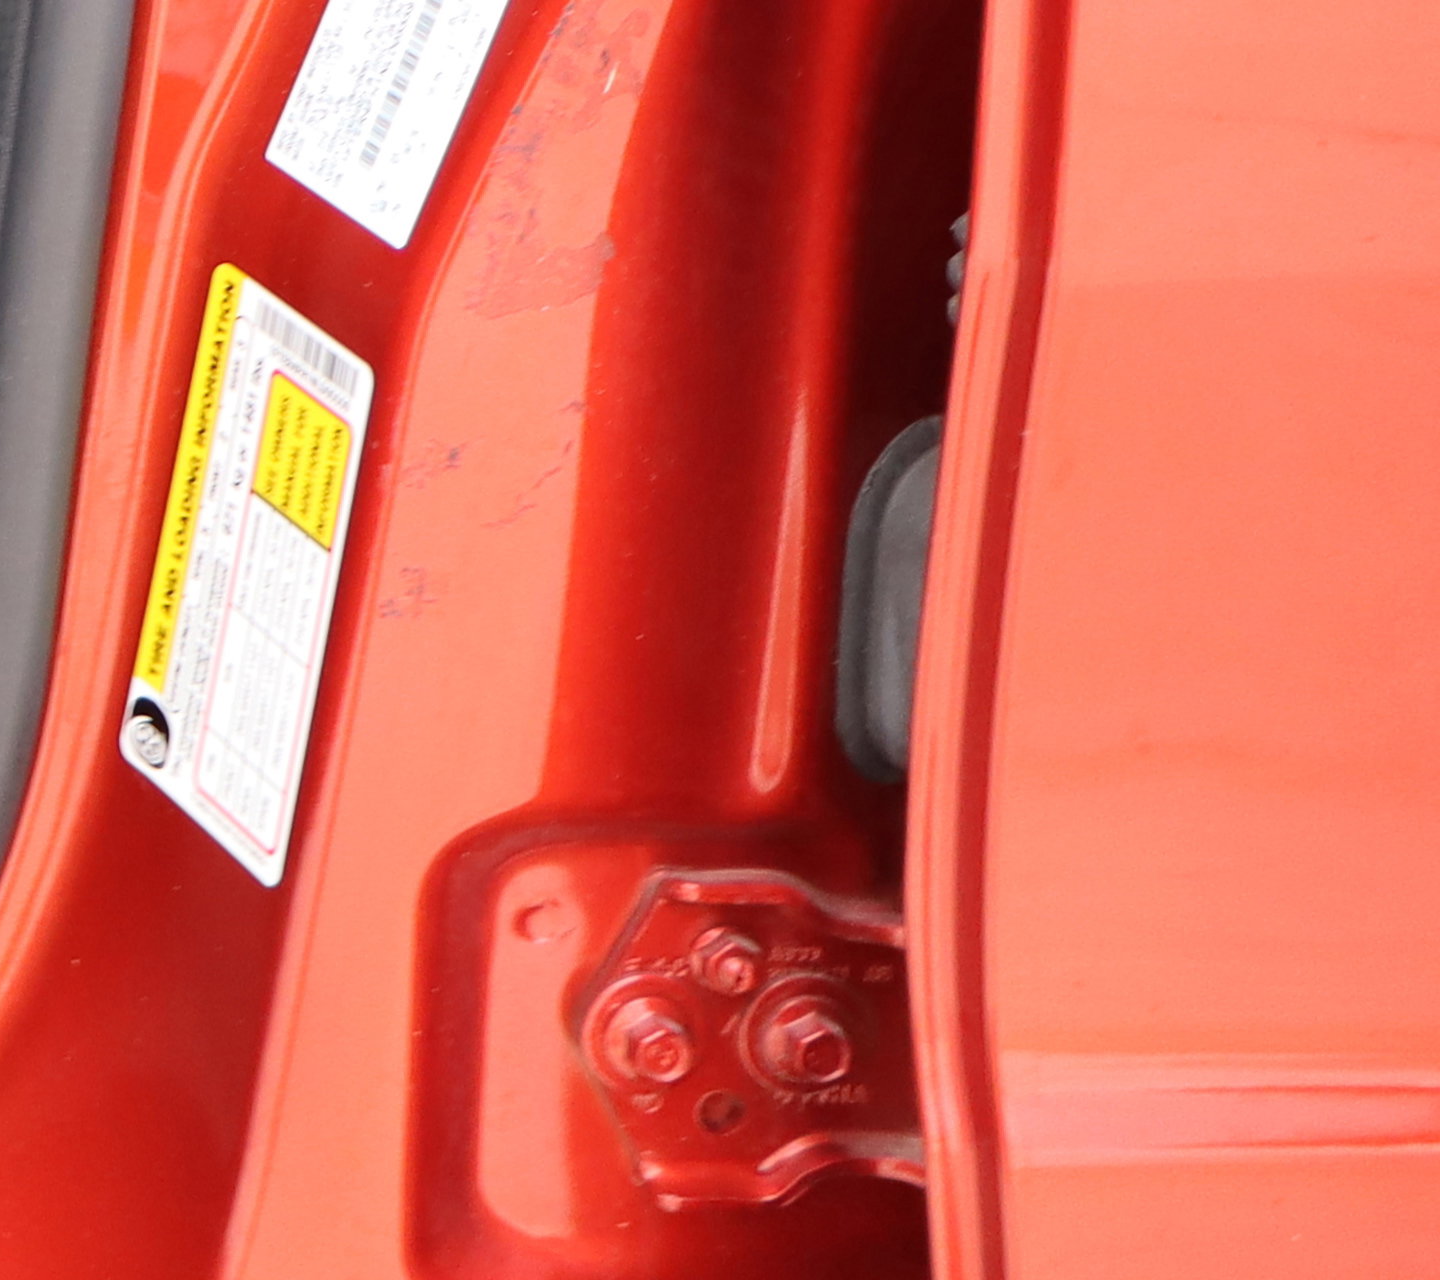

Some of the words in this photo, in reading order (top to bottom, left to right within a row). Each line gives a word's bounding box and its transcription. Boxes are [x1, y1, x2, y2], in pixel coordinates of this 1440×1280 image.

[148, 624, 168, 677] TIRE
[161, 567, 178, 616] AND
[172, 455, 201, 562] LOADING
[195, 280, 235, 447] INFORMATION
